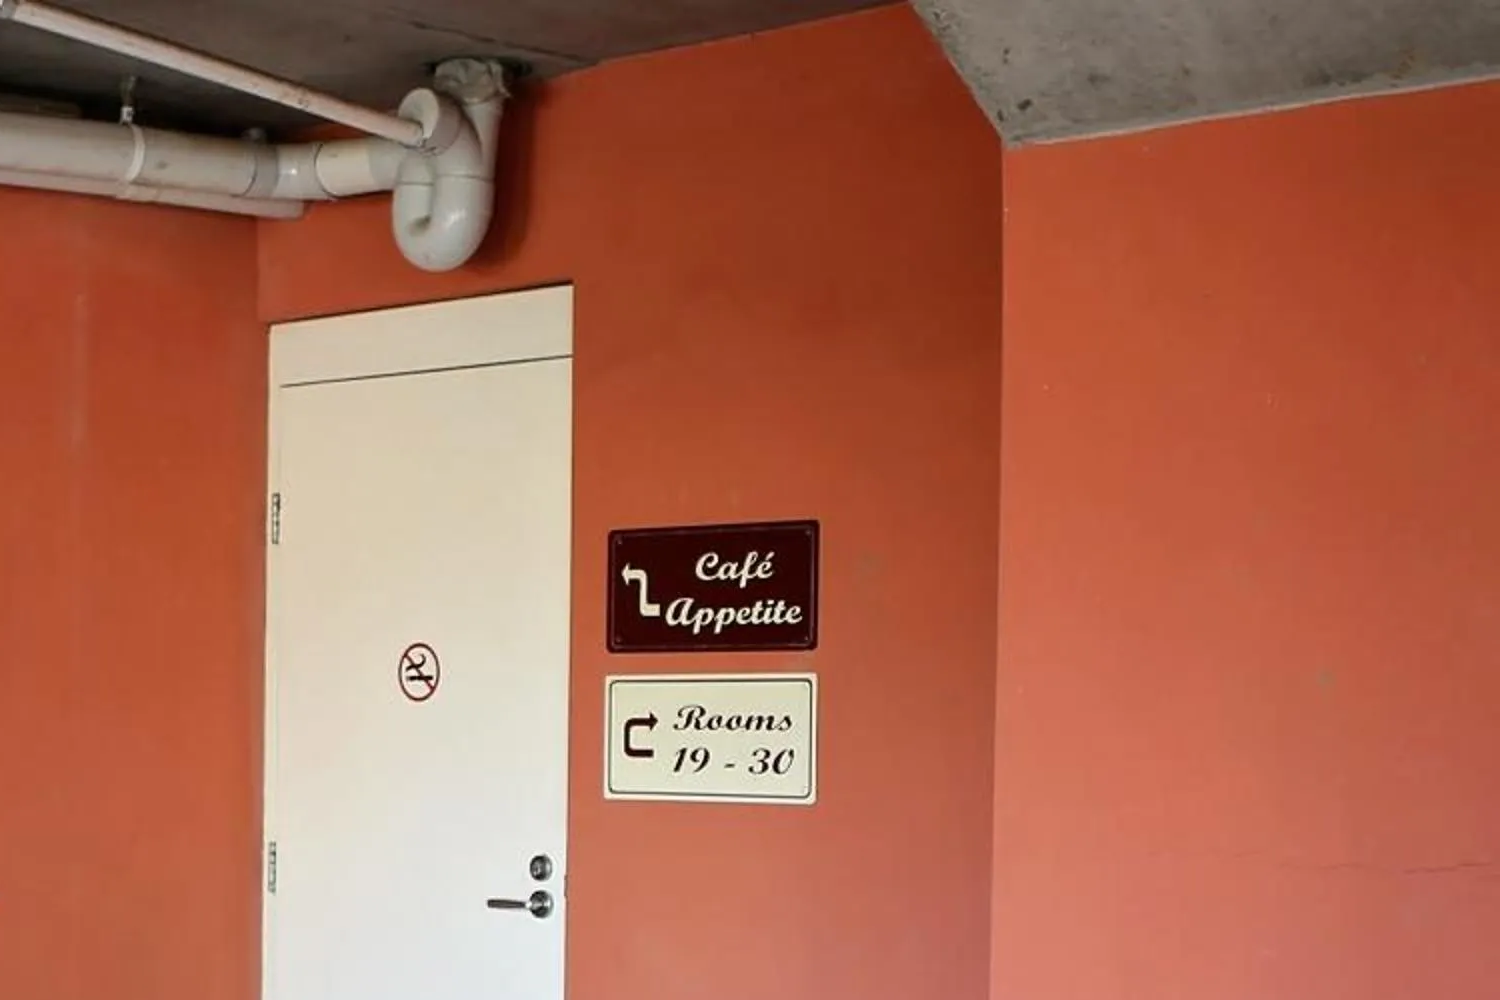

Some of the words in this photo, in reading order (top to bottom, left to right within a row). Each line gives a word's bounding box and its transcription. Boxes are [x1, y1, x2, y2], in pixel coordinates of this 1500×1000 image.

[695, 551, 775, 588] Café
[665, 597, 803, 635] Appetite
[672, 704, 793, 732] Rooms
[672, 747, 711, 773] 19
[747, 747, 795, 775] 30
